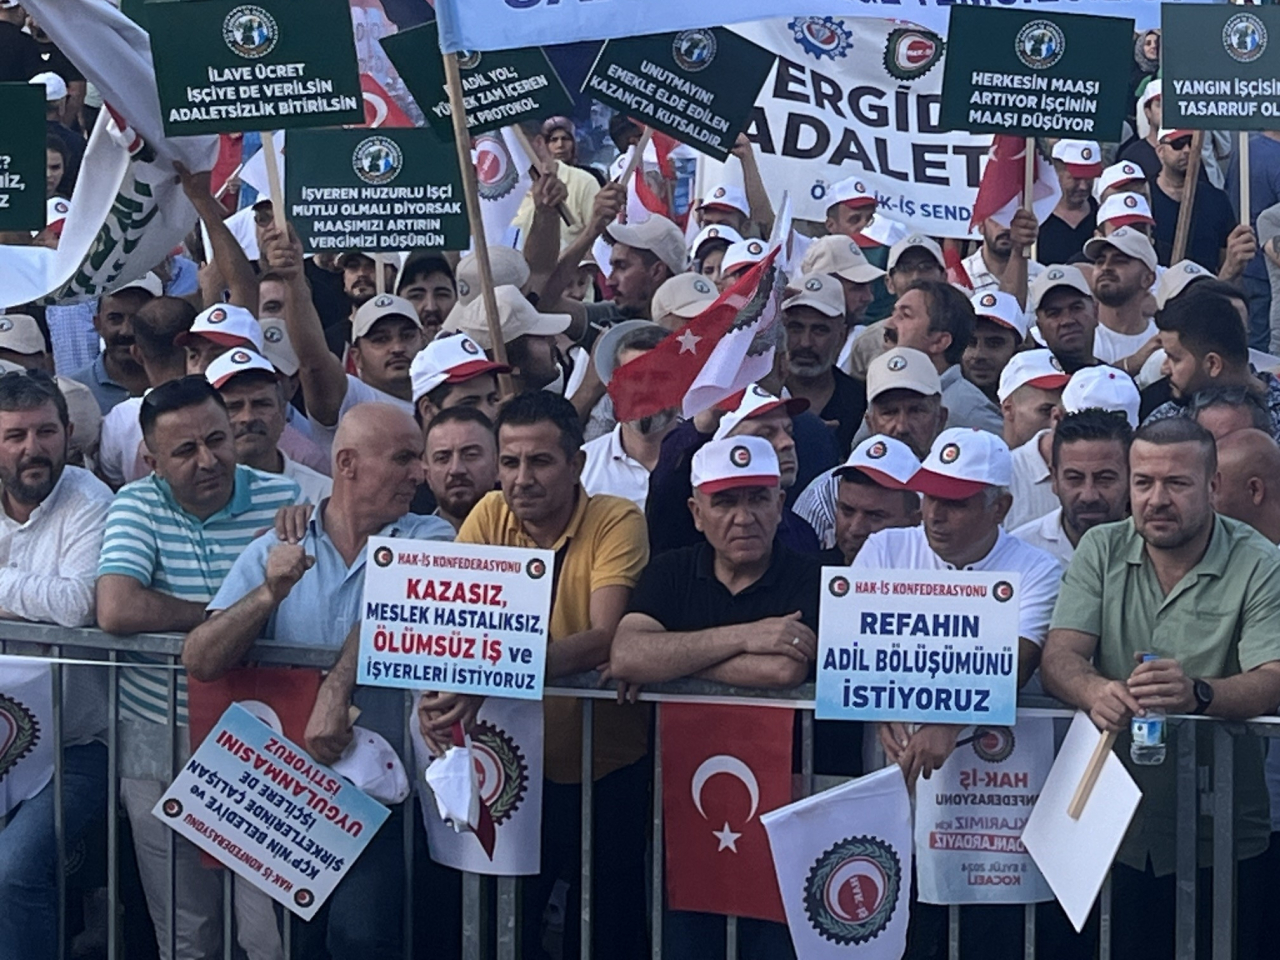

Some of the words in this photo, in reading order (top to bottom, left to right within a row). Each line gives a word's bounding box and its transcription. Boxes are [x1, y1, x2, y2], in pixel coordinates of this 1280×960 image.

[208, 65, 252, 82] İLAVE
[255, 63, 305, 79] ÜCRET
[462, 73, 490, 91] ADİL
[488, 66, 518, 82] YOL;
[640, 60, 714, 105] UNUTMAYIN!
[972, 72, 1047, 91] HERKESİN
[1051, 77, 1099, 96] MAAŞI
[187, 84, 236, 103] İŞÇİYE
[240, 85, 260, 99] DE
[263, 78, 333, 98] VERİLSİN
[432, 95, 479, 118] YÜEK
[477, 88, 505, 105] ZAM
[504, 75, 548, 98] İÇEREN
[607, 64, 657, 95] EMEKLE
[655, 88, 685, 112] ELDE
[687, 104, 730, 132] EDİLEN
[772, 56, 940, 133] ERGİD
[1173, 80, 1231, 96] YANGIN
[169, 101, 277, 122] ADALETSİZLİK
[278, 95, 357, 115] BİTİRİLSİN
[477, 98, 539, 124] PROTOKOL
[970, 91, 1038, 110] ARTIYOR
[1040, 94, 1097, 114] İŞÇİNİN
[1178, 100, 1257, 116] TASARRUF
[968, 111, 1018, 128] MAAŞI
[1021, 111, 1094, 132] DÜŞÜYOR
[746, 106, 990, 188] ADALET
[302, 186, 358, 201] İŞVEREN
[361, 187, 424, 199] HUZURLU
[427, 184, 452, 200] İŞÇİ
[292, 204, 338, 216] MUTLU
[340, 203, 391, 216] OLMALI
[394, 200, 461, 214] DİYORSAK
[920, 203, 972, 221] SEND
[313, 219, 383, 234] MAAŞIMIZI
[387, 218, 440, 231] ARTIRIN
[309, 234, 377, 248] VERGİMİZİ
[380, 233, 444, 248] DÜŞÜRÜN
[433, 556, 521, 574] KONFEDERASYONU
[406, 578, 507, 608] KAZASIZ,
[893, 582, 988, 597] KONFEDERASYONU
[366, 602, 429, 624] MESLEK
[434, 607, 544, 636] HASTALIKSIZ,
[860, 612, 980, 638] REFAHIN
[374, 624, 476, 659] ÖLÜMSÜZ
[482, 633, 502, 666] İŞ
[508, 646, 532, 664] ve
[367, 656, 448, 683] İŞYERLERİ
[452, 662, 536, 690] İSTİYORUZ
[823, 642, 870, 671] ADİL
[875, 642, 1013, 679] BÖLÜŞÜMÜNÜ
[843, 678, 991, 712] İSTİYORUZ
[239, 771, 263, 790] DE
[264, 737, 342, 800] İSTİYORUZ
[187, 759, 246, 805] ÇALIŞAN
[190, 784, 205, 800] ve
[215, 730, 363, 838] UYGULANMASINI
[205, 796, 268, 845] BELEDİYE
[258, 788, 317, 833] İŞÇİLERE
[183, 813, 264, 873] KONFEDERASYONU
[244, 803, 344, 872] ŞİRKETLERİNDE
